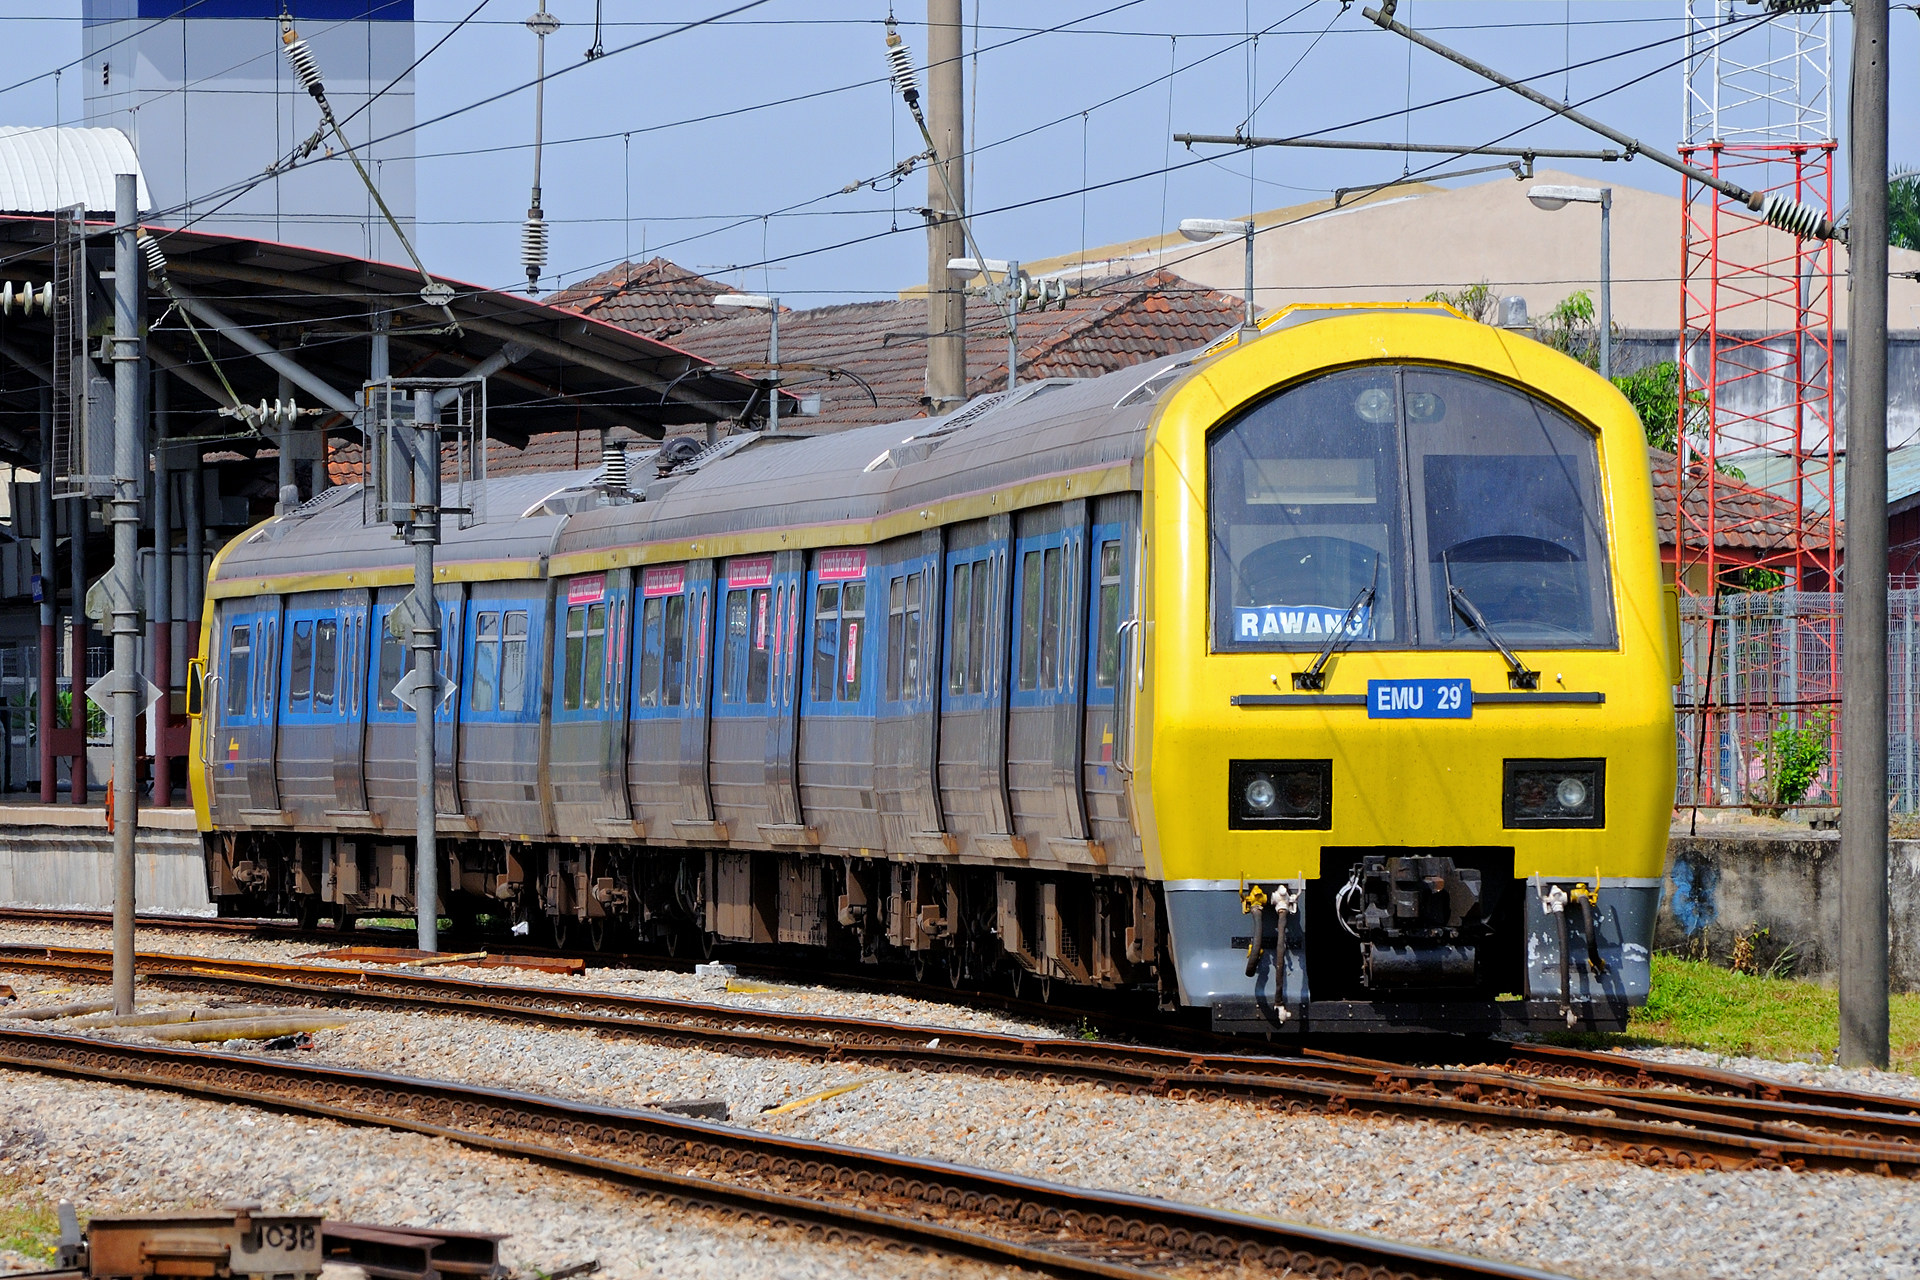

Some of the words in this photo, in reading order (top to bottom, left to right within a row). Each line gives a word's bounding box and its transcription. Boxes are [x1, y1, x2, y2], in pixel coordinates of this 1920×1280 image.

[1241, 612, 1363, 637] RAWANG
[1377, 687, 1423, 711] EMU
[1437, 686, 1462, 710] 29
